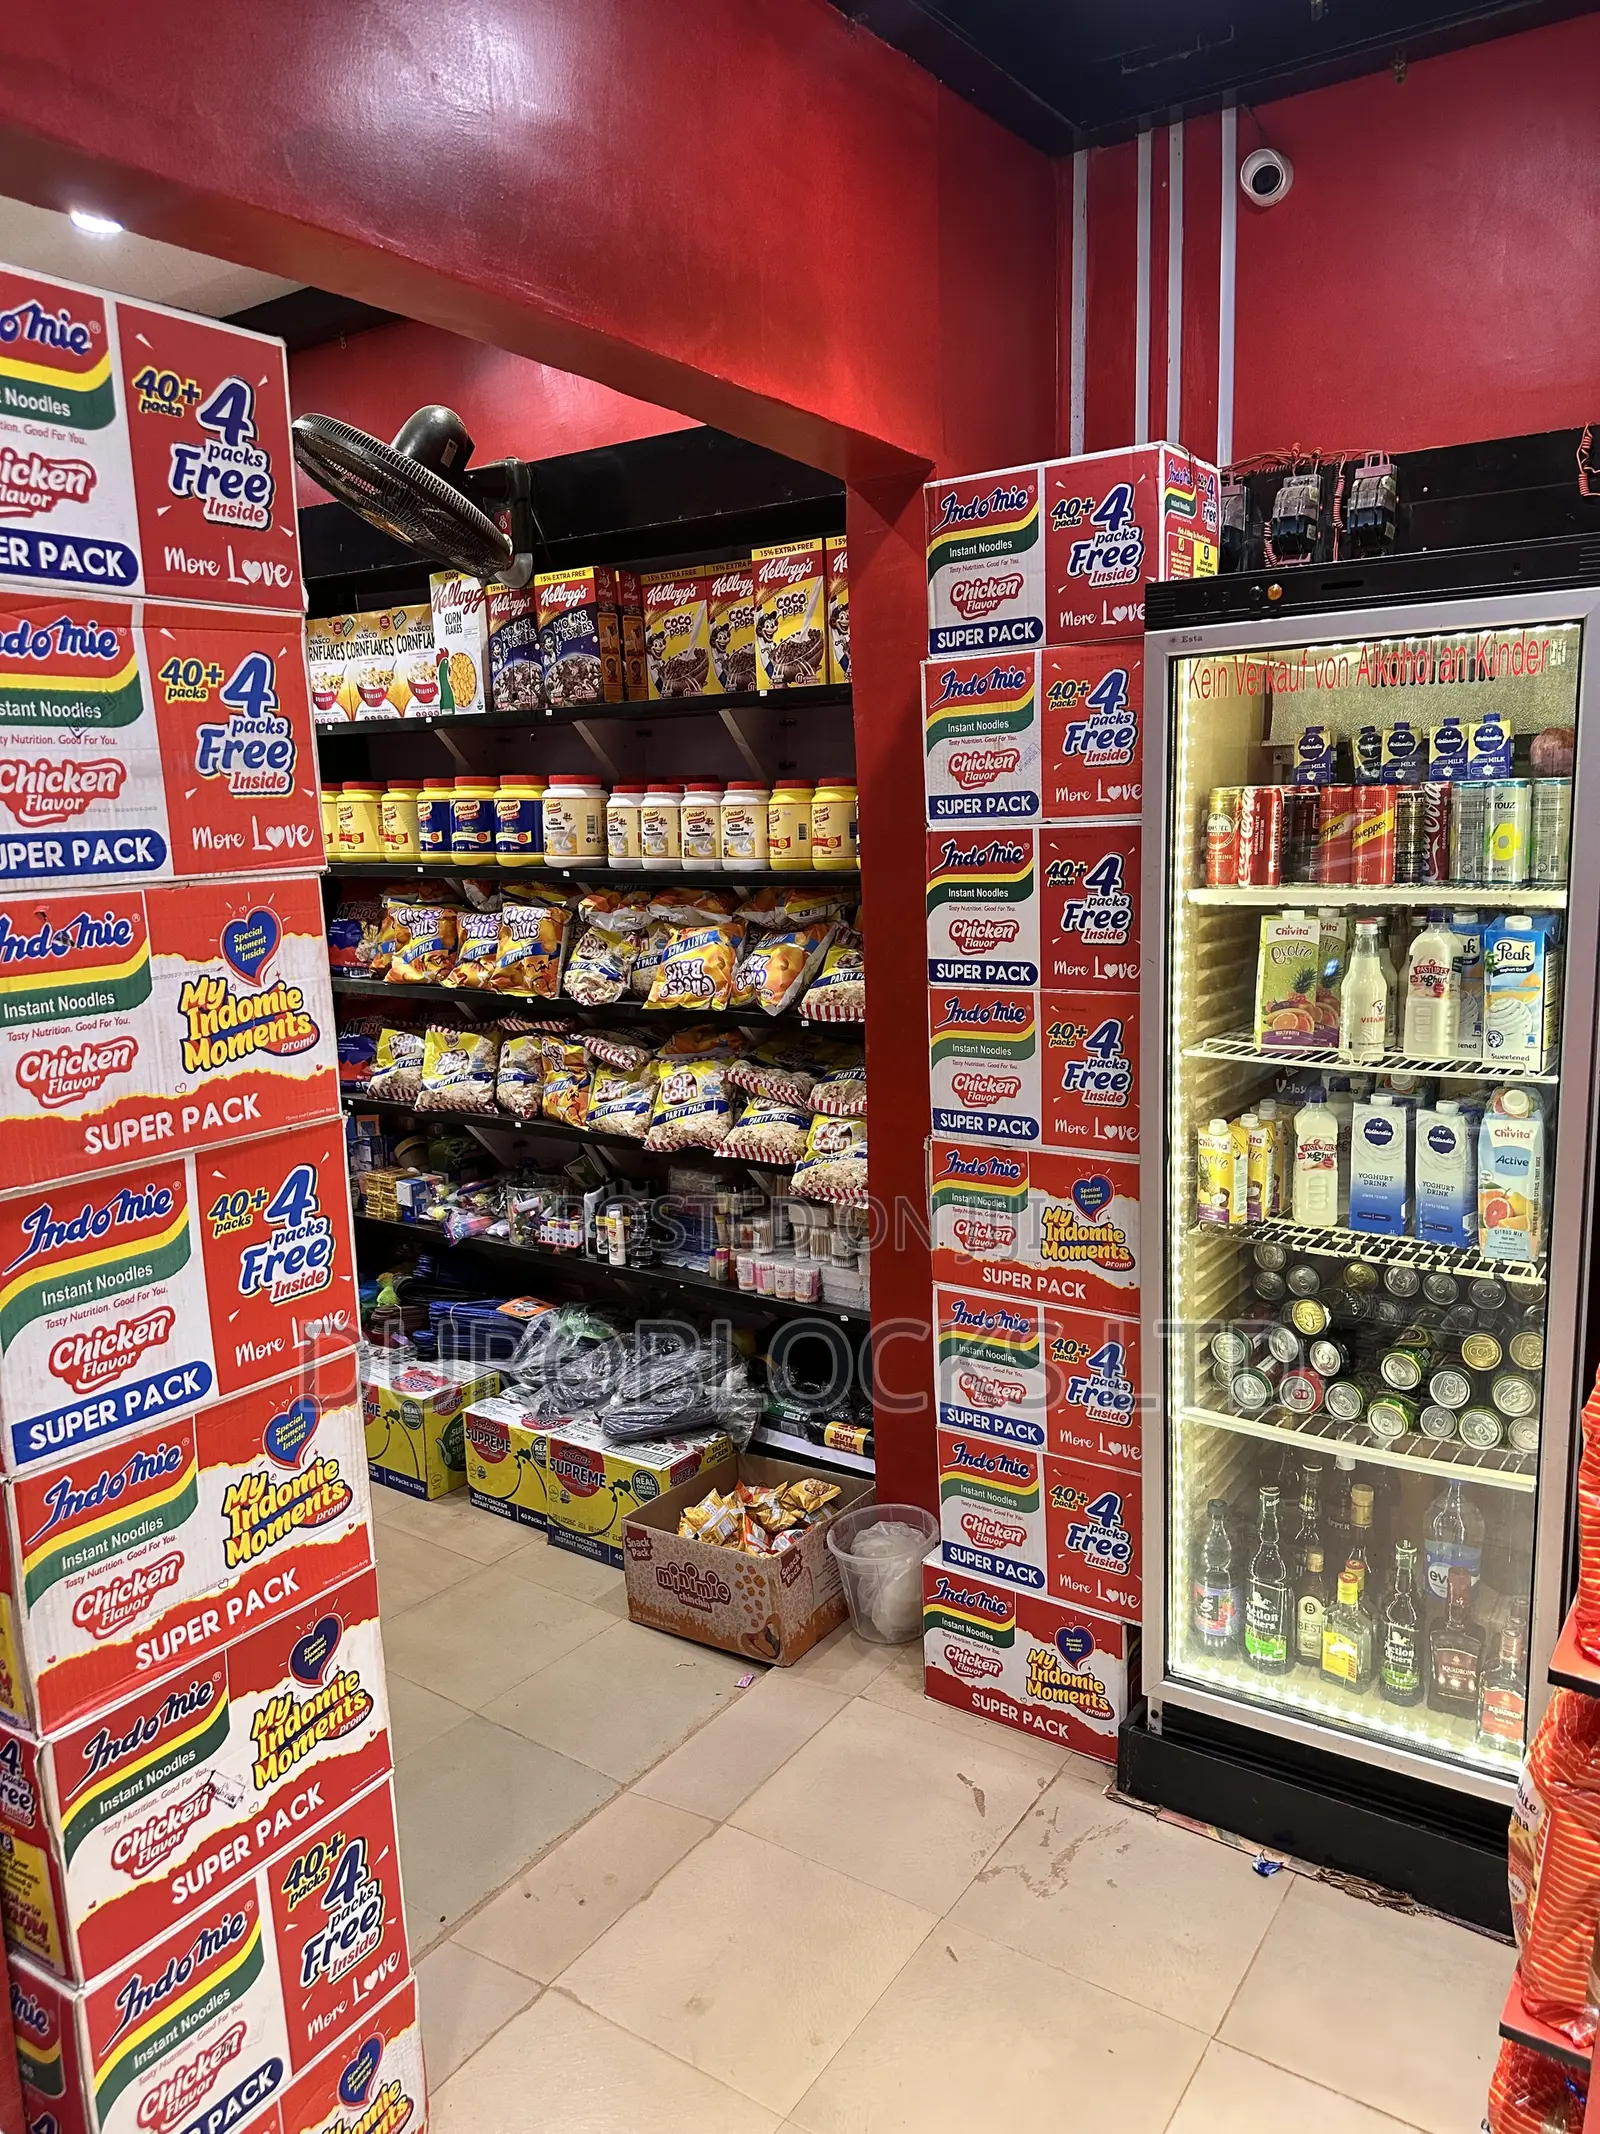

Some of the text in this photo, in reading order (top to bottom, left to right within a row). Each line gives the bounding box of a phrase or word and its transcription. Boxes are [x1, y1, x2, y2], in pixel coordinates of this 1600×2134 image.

[133, 370, 201, 405] 40+
[198, 377, 257, 446] 4
[170, 446, 268, 504] Free
[207, 498, 265, 522] Inside
[760, 541, 814, 558] 15% EXTRA FREE
[1068, 540, 1144, 576] Free
[39, 541, 127, 579] PACK
[444, 572, 459, 580] 500g
[540, 570, 586, 583] 15% EXTRA FREE
[661, 571, 680, 579] EXTRA
[681, 568, 697, 576] FREE
[759, 559, 813, 583] Kellogg's
[541, 584, 588, 607] Kellogg's
[647, 584, 697, 606] Kellogg's
[776, 595, 806, 609] COCO
[444, 612, 461, 625] CORN
[782, 605, 804, 618] pops
[445, 624, 463, 635] FLAKES
[664, 615, 691, 631] COCO
[669, 626, 690, 638] pops
[938, 620, 1037, 651] SUPER PACK
[346, 637, 394, 660] CORNFLAKES
[1189, 631, 1550, 699] Kein Verkauf von Alkohol an Kinder
[41, 702, 102, 719] Noodles
[197, 727, 290, 775] Free
[950, 749, 1017, 773] Chicken
[1046, 861, 1088, 880] 40+
[948, 888, 1010, 899] Instant Noodles
[1275, 926, 1309, 937] Chivita
[686, 933, 710, 950] PARTY
[1496, 940, 1531, 961] Peak
[1271, 944, 1312, 965] exotic
[664, 960, 705, 980] Balls
[830, 973, 854, 984] PARTY
[180, 976, 227, 1013] My
[661, 980, 716, 998] Cheese
[4, 990, 116, 1019] Instant Noodles
[186, 982, 304, 1041] Indomie
[181, 1013, 314, 1074] Moments
[280, 1033, 316, 1054] promo
[19, 1042, 132, 1082] Chicken
[1490, 1052, 1530, 1061] Sweetened
[48, 1074, 101, 1096] Flavor
[663, 1073, 693, 1089] POP
[662, 1086, 697, 1103] CORN
[611, 1103, 627, 1112] PACK
[665, 1103, 706, 1120] PARTY PACK
[83, 1092, 262, 1155] SUPER PACK
[748, 1113, 788, 1125] PARTY PACK
[940, 1112, 1033, 1137] SUPER PACK
[1365, 1128, 1394, 1137] Hollandia
[1493, 1126, 1531, 1139] Chivita
[1495, 1154, 1530, 1167] Active
[1358, 1172, 1393, 1182] YOGHURT
[1363, 1179, 1388, 1188] DRINK
[1422, 1181, 1456, 1192] YOGHURT
[1426, 1188, 1450, 1198] DRINK
[272, 1219, 325, 1249] packs
[1041, 1242, 1131, 1260] Moments
[112, 1285, 169, 1311] Good For You.
[29, 1368, 202, 1452] SUPER PACK
[403, 1406, 419, 1416] REAL
[1087, 1407, 1128, 1423] Inside
[465, 1427, 512, 1452] SUPREME
[834, 1432, 855, 1442] DUTY
[705, 1448, 729, 1464] CHICKEN
[711, 1442, 728, 1453] TASTY
[550, 1458, 607, 1488] SUPREME
[635, 1477, 655, 1487] REAL
[473, 1492, 508, 1509] TASTY CHICKEN
[489, 1504, 512, 1516] NOODLES
[225, 1481, 347, 1568] Moments
[574, 1537, 598, 1549] CHICKEN
[576, 1543, 602, 1556] NOODLES
[626, 1537, 650, 1550] Snack
[631, 1547, 651, 1558] Pack
[780, 1555, 802, 1579] Snack
[656, 1563, 732, 1604] minimie
[1298, 1621, 1322, 1631] BEST
[971, 1693, 1070, 1739] SUPER PACK
[99, 1749, 197, 1815] Instant Noodles
[115, 1787, 214, 1862] Chicken
[283, 1830, 346, 1892] 40+
[301, 1898, 381, 1988] Free
[306, 1997, 349, 2043] More
